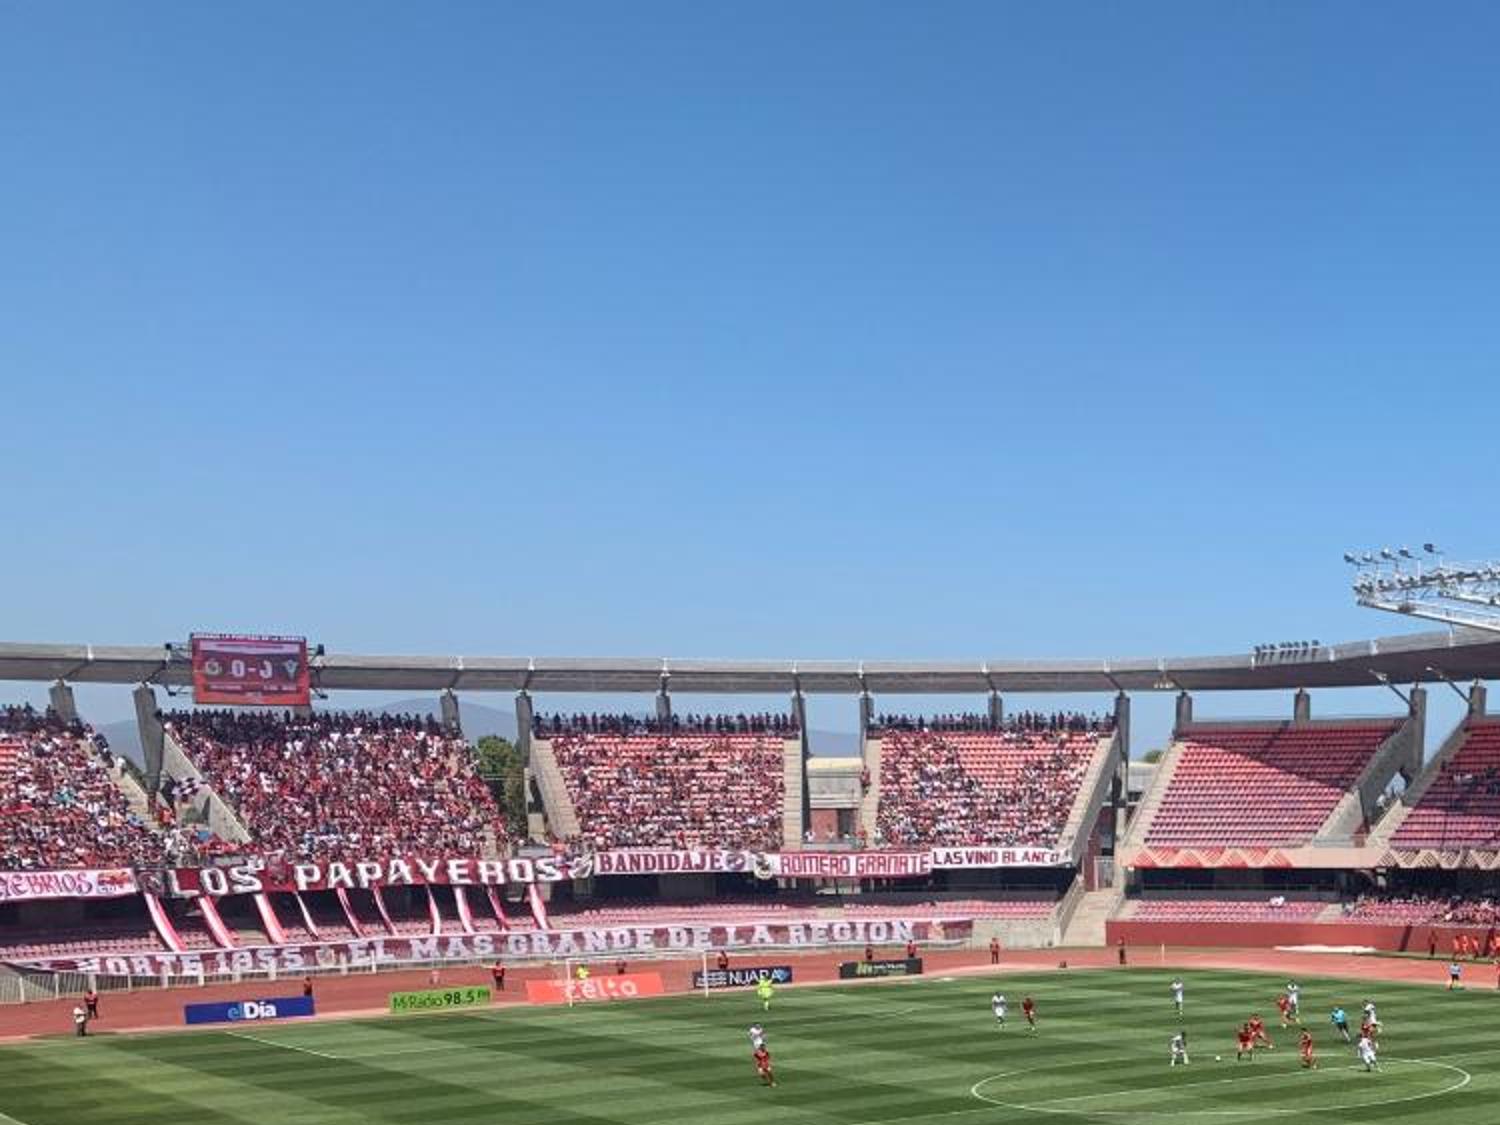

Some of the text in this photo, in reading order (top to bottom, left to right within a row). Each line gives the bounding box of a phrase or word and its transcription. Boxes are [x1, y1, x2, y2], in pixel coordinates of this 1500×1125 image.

[167, 857, 563, 898] LOS PAPAYEROS
[600, 853, 722, 873] BANDIDAJE
[410, 934, 494, 959] MAS
[506, 926, 655, 956] GRANDE
[667, 927, 712, 949] DE
[726, 924, 775, 947] LA
[789, 919, 915, 945] REGION
